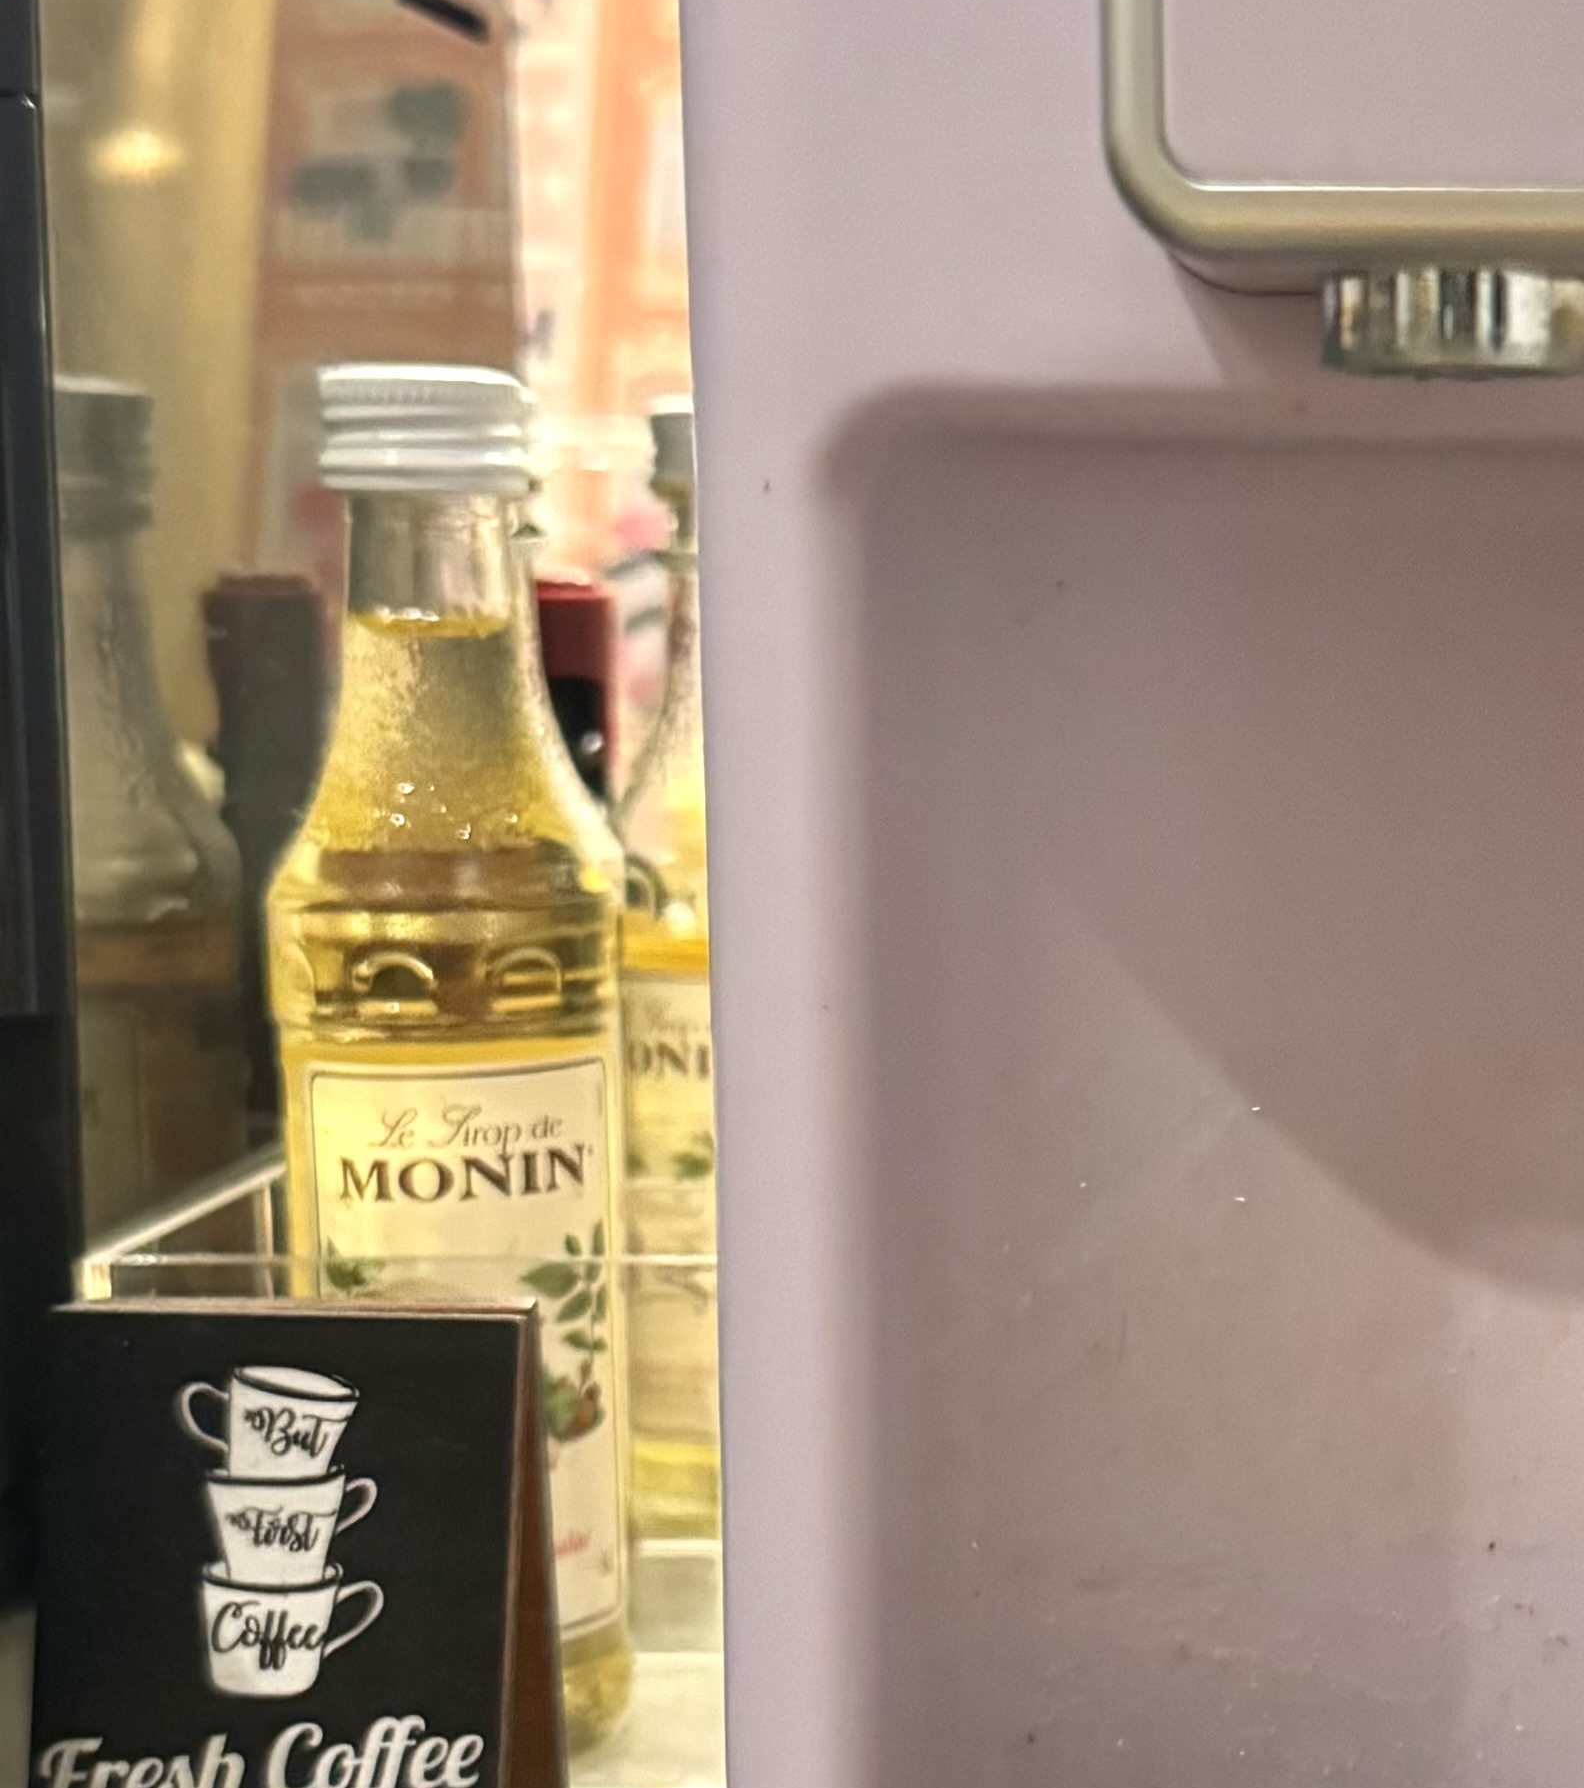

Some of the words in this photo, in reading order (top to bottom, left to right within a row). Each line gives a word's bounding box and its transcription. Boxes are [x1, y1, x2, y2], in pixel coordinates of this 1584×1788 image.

[368, 1108, 416, 1149] Le
[426, 1104, 523, 1154] Sirop
[530, 1113, 564, 1141] de
[338, 1142, 588, 1203] MONIN
[244, 1405, 348, 1459] But
[210, 1601, 327, 1672] Coffee
